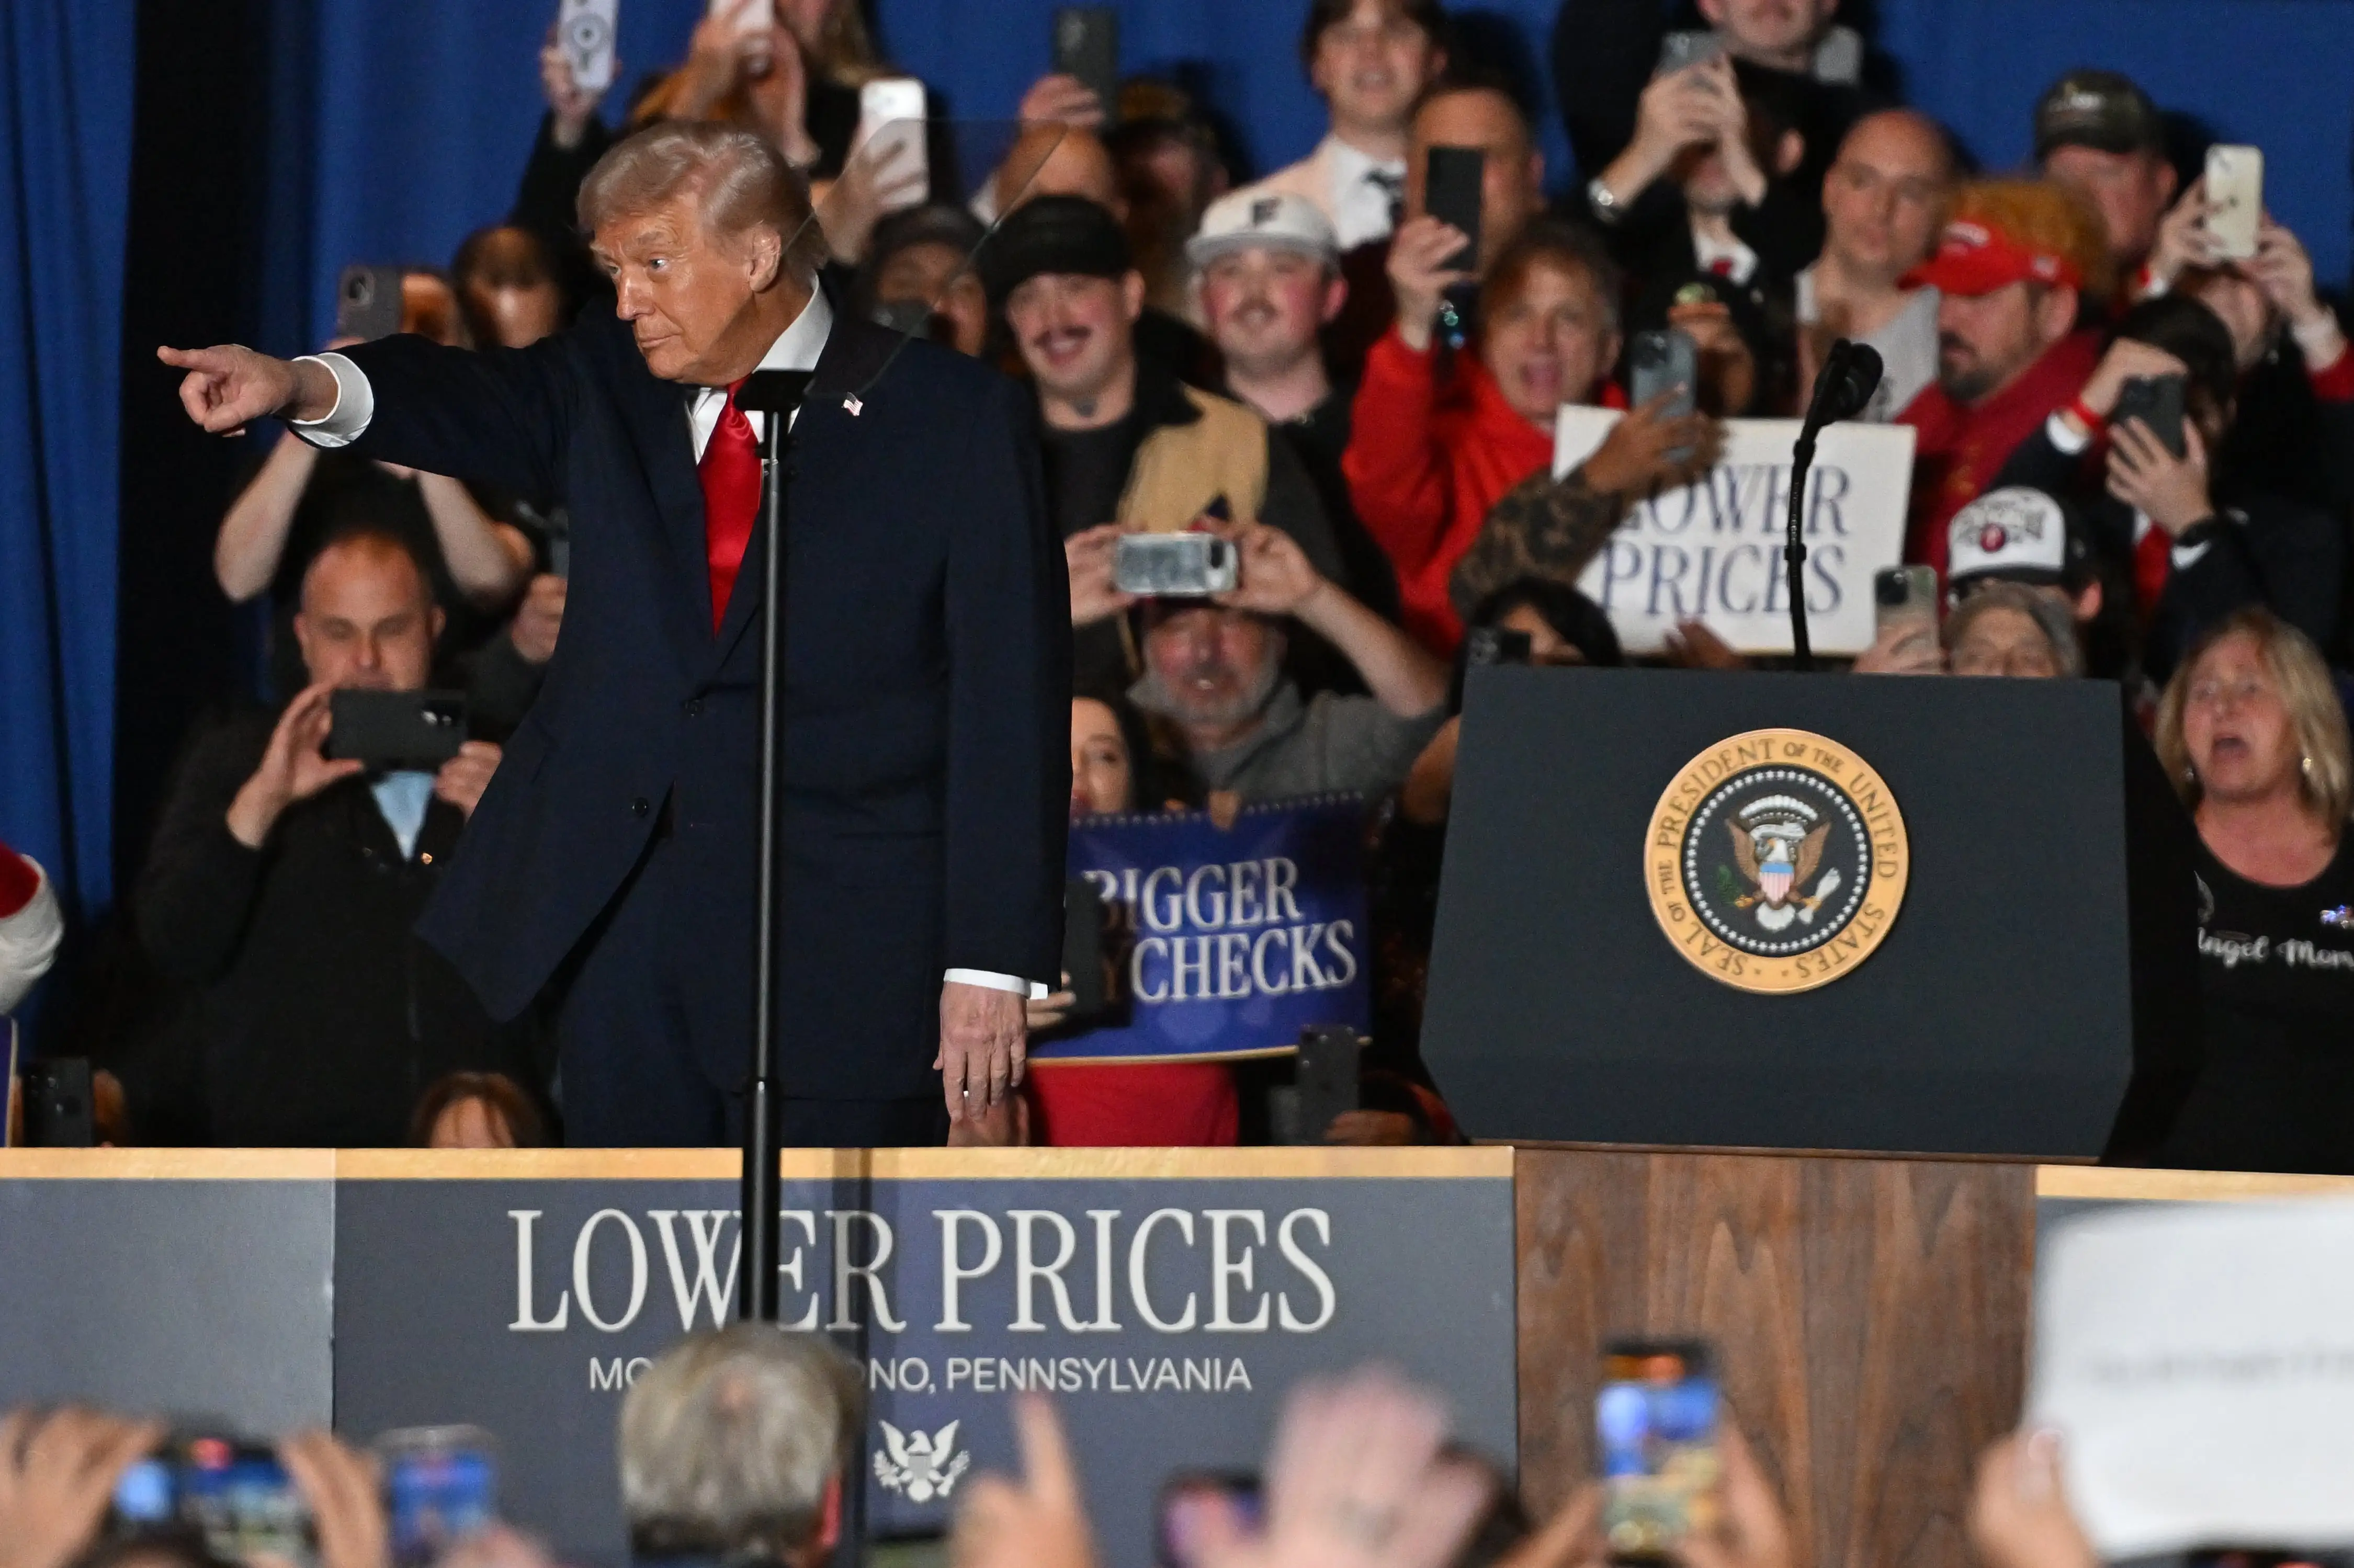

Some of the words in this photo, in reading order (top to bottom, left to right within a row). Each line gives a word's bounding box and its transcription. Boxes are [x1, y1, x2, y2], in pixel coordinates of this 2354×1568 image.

[1621, 464, 1850, 536] OWER
[1602, 542, 1845, 616] PRICES
[1657, 738, 1776, 850] PRESIDENT
[1813, 747, 1845, 774] THE
[1849, 772, 1899, 878] UNITED
[1658, 859, 1675, 895] THE
[1686, 922, 1749, 976] SEAL
[1794, 902, 1885, 978] STATES
[507, 1208, 907, 1332] LOWER
[933, 1208, 1336, 1333] PRICES
[947, 1357, 1251, 1392] PENNSYLVANIA
